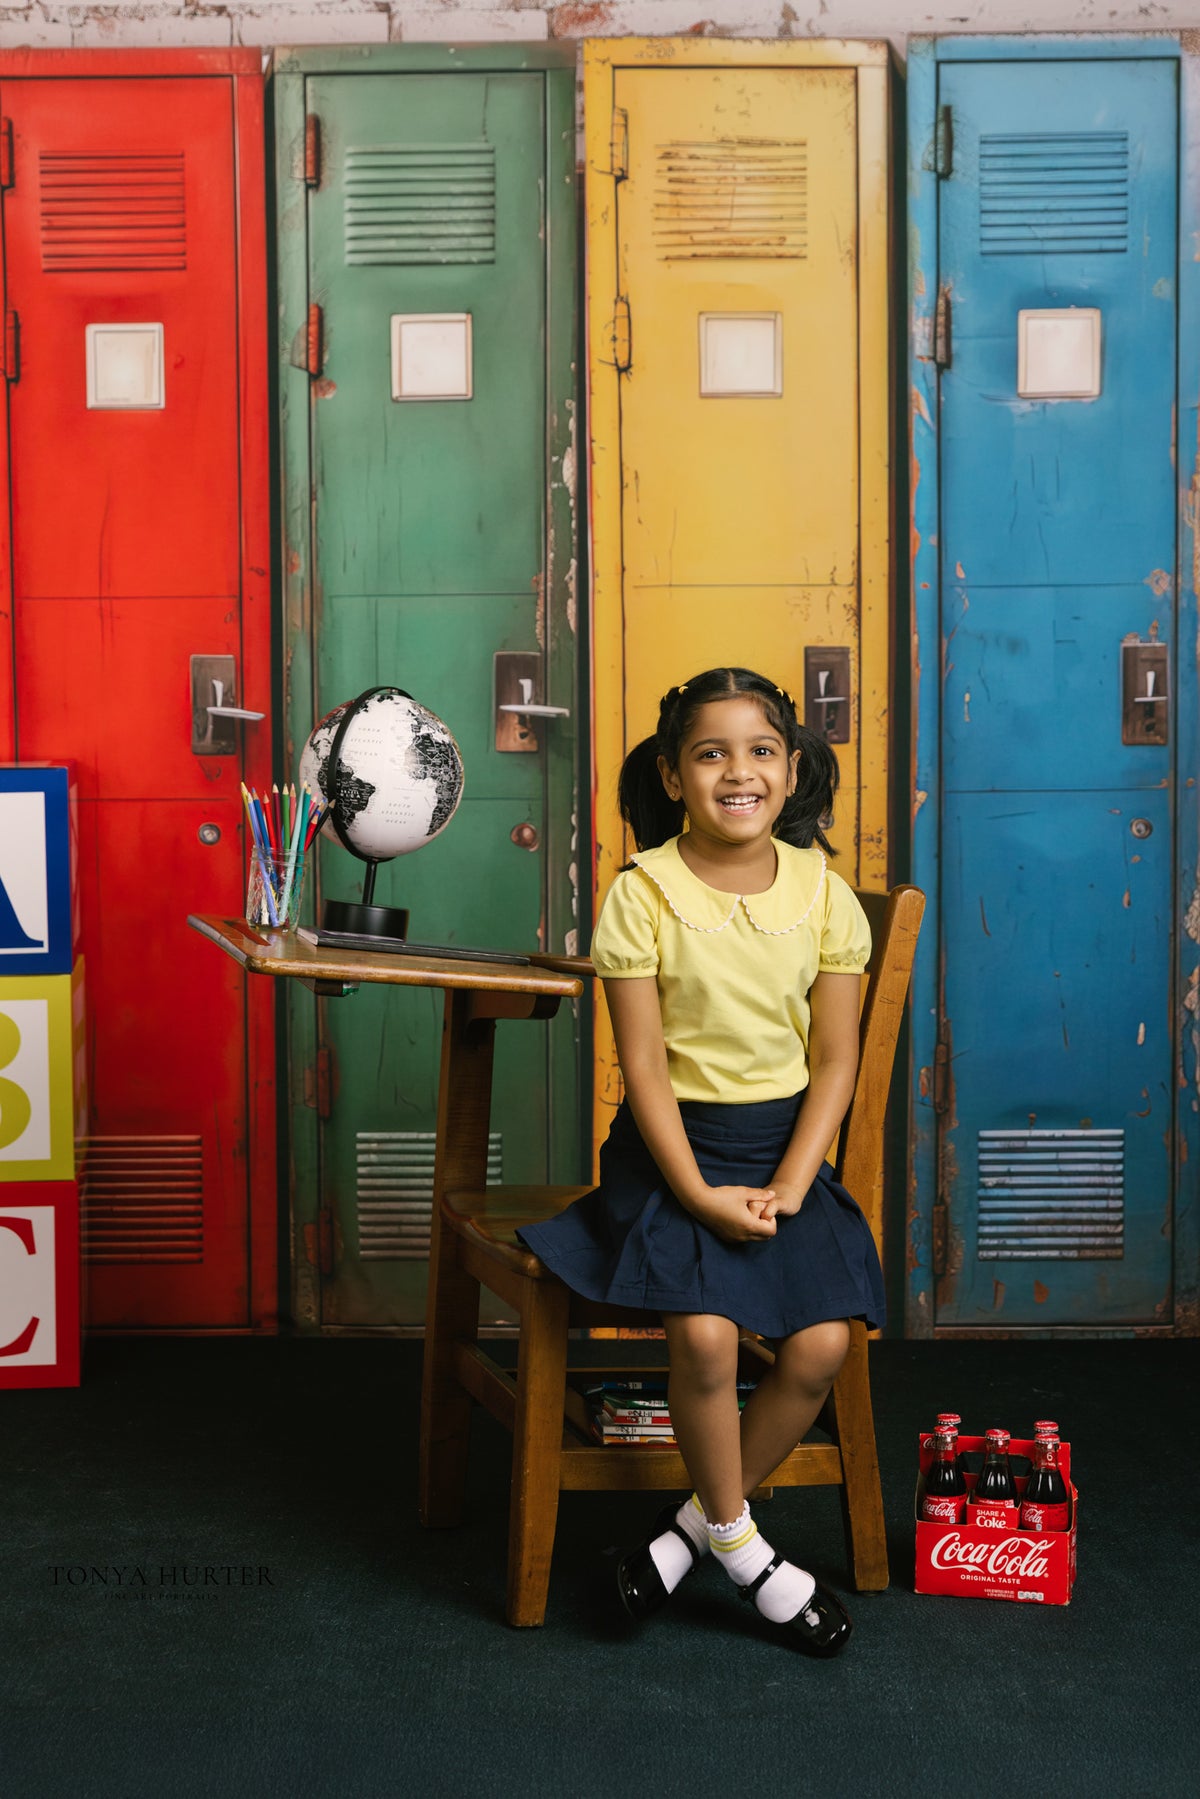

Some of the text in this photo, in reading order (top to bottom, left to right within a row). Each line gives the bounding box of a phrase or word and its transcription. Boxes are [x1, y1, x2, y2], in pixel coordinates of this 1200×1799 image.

[1046, 1452, 1053, 1461] 6
[977, 1509, 999, 1517] SHARE
[976, 1516, 1006, 1529] Coke
[931, 1532, 1056, 1577] Coca-Cola
[961, 1574, 1021, 1585] ORIGINAL TASTE
